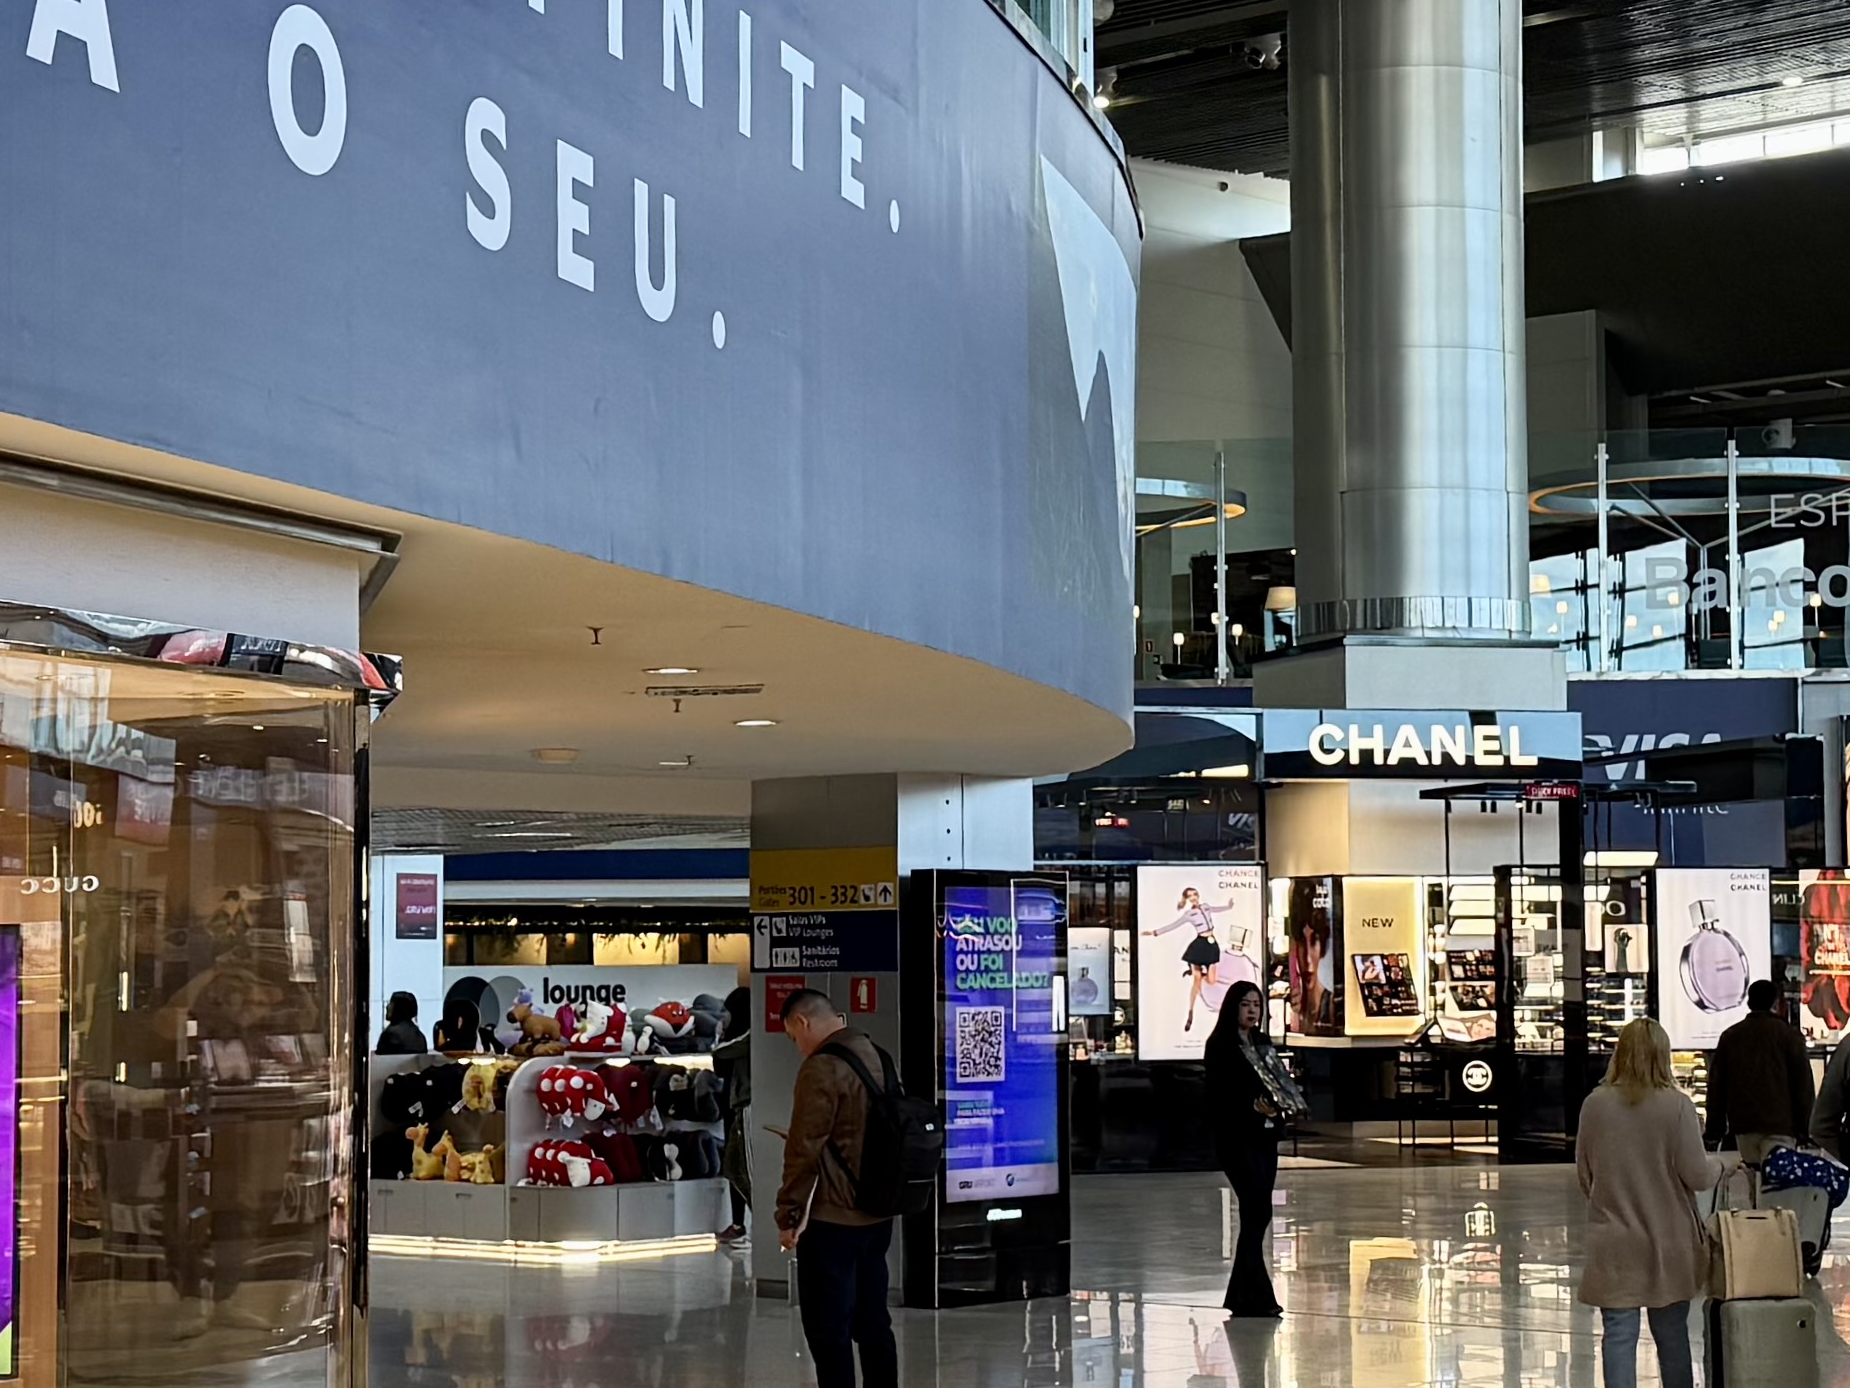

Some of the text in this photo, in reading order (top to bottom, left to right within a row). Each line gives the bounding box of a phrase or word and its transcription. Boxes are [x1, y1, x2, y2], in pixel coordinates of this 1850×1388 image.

[267, 4, 347, 176] O
[464, 97, 726, 350] SEU.
[1308, 723, 1539, 766] CHANEL
[788, 886, 815, 906] 301
[830, 885, 859, 905] 332
[1218, 881, 1259, 889] CHANEL
[1362, 918, 1394, 928] NEW
[955, 953, 1004, 971] OU FOI
[543, 976, 627, 1006] lounge
